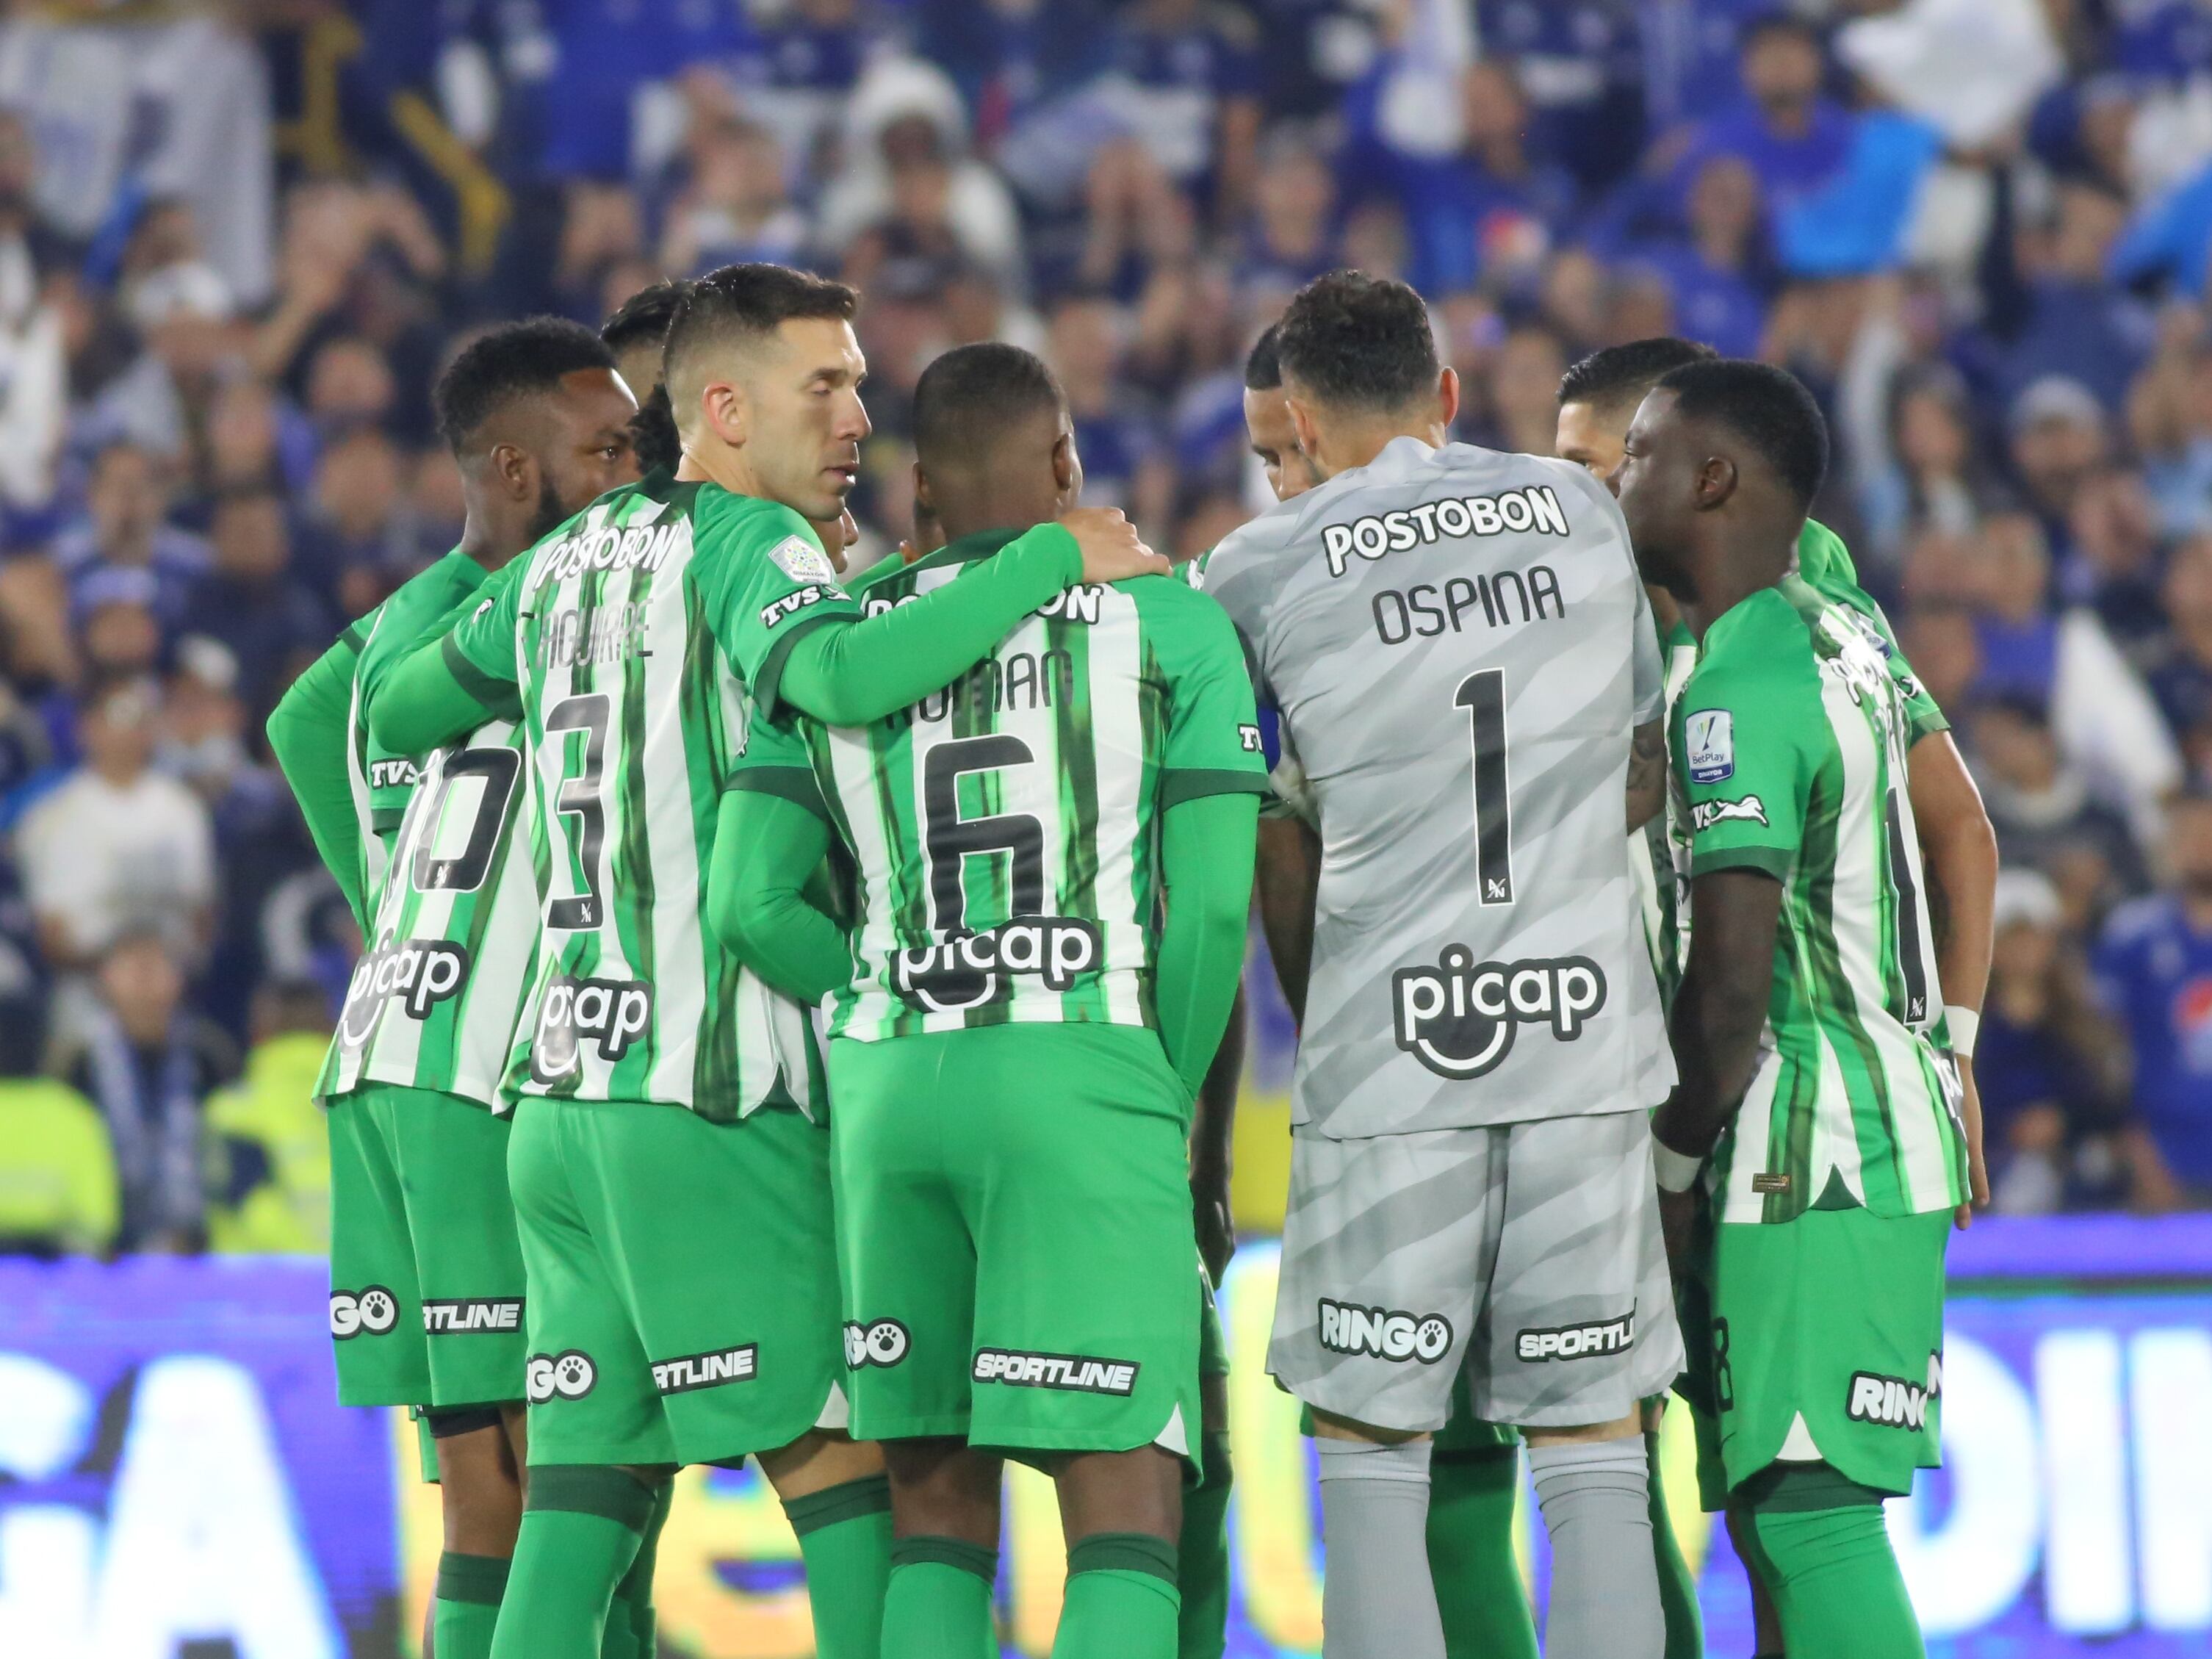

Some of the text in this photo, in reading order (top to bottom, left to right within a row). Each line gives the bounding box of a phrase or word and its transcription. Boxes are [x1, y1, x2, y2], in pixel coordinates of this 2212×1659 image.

[535, 522, 680, 590] POSTOBON
[1322, 486, 1570, 577] POSTOBON
[760, 585, 821, 627] TVS
[1372, 565, 1566, 644] OSPINA
[1452, 666, 1516, 907] 1
[1692, 752, 1724, 765] BetPlay
[544, 693, 610, 932] 3
[923, 734, 1046, 931] 6
[340, 938, 461, 1023] picap
[1402, 953, 1598, 1041] picap
[1320, 1301, 1449, 1361] RINGO
[526, 1354, 594, 1402] GO
[974, 1352, 1136, 1391] SPORTLINE
